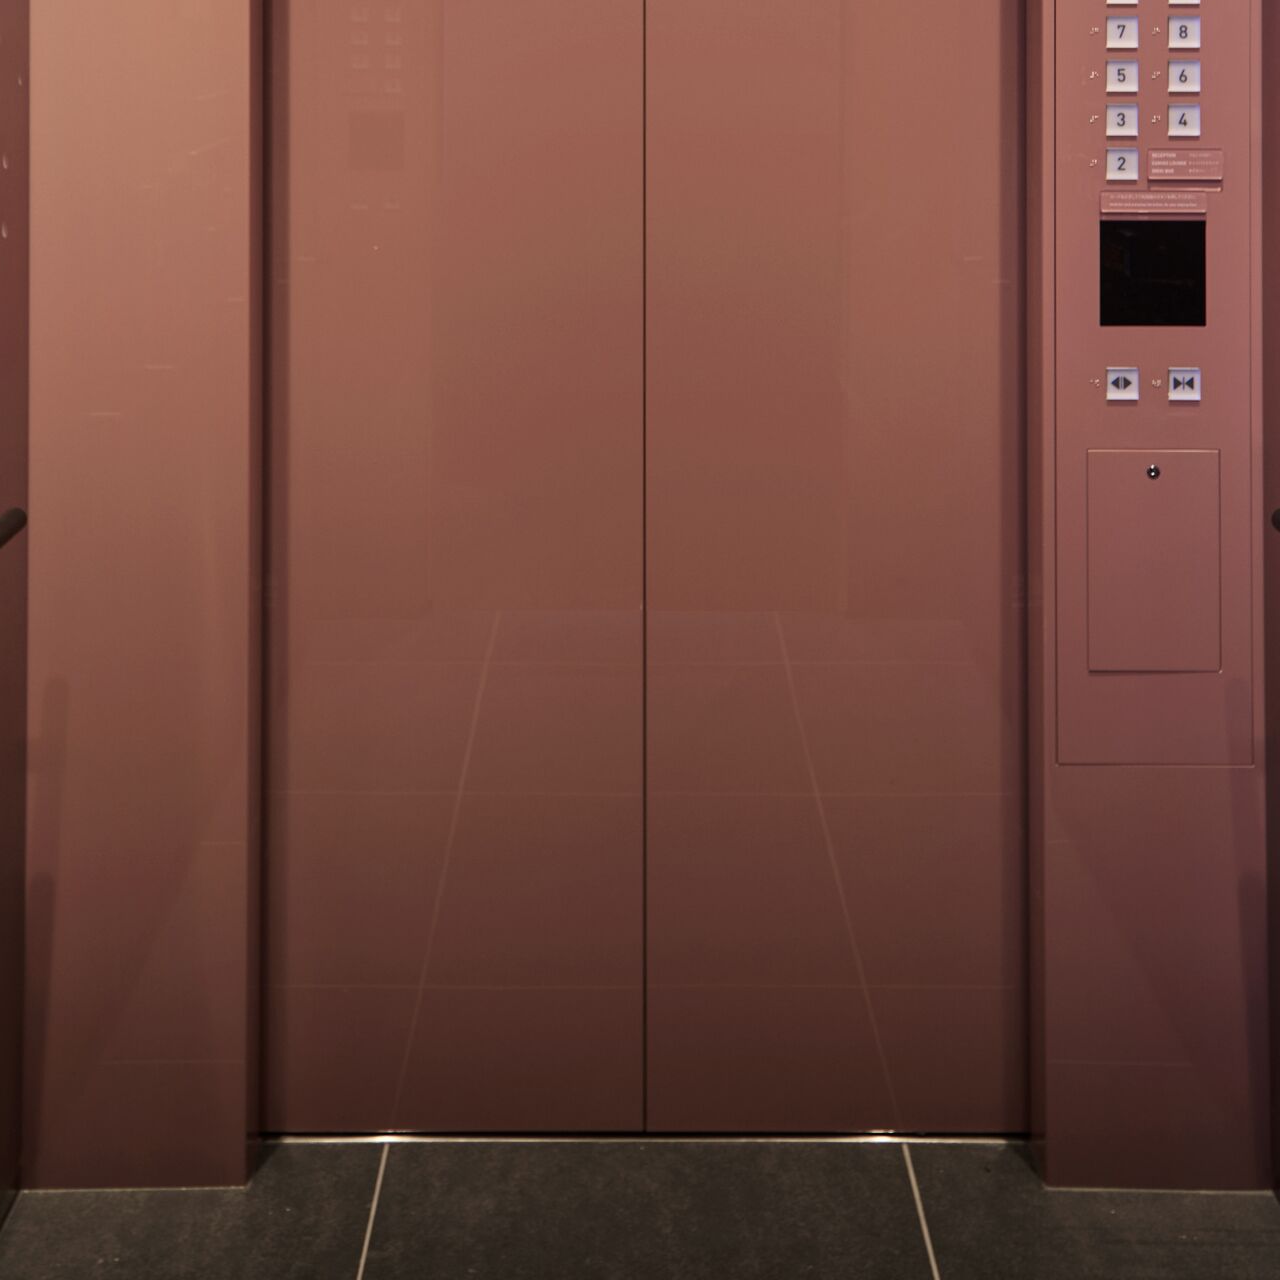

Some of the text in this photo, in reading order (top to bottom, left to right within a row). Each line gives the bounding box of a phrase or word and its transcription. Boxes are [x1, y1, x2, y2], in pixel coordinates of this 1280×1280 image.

[1117, 24, 1126, 39] 7
[1179, 24, 1188, 39] 8
[1117, 68, 1126, 83] 5
[1179, 68, 1188, 83] 6
[1116, 112, 1126, 127] 3
[1178, 112, 1188, 127] 4
[1117, 156, 1126, 171] 2
